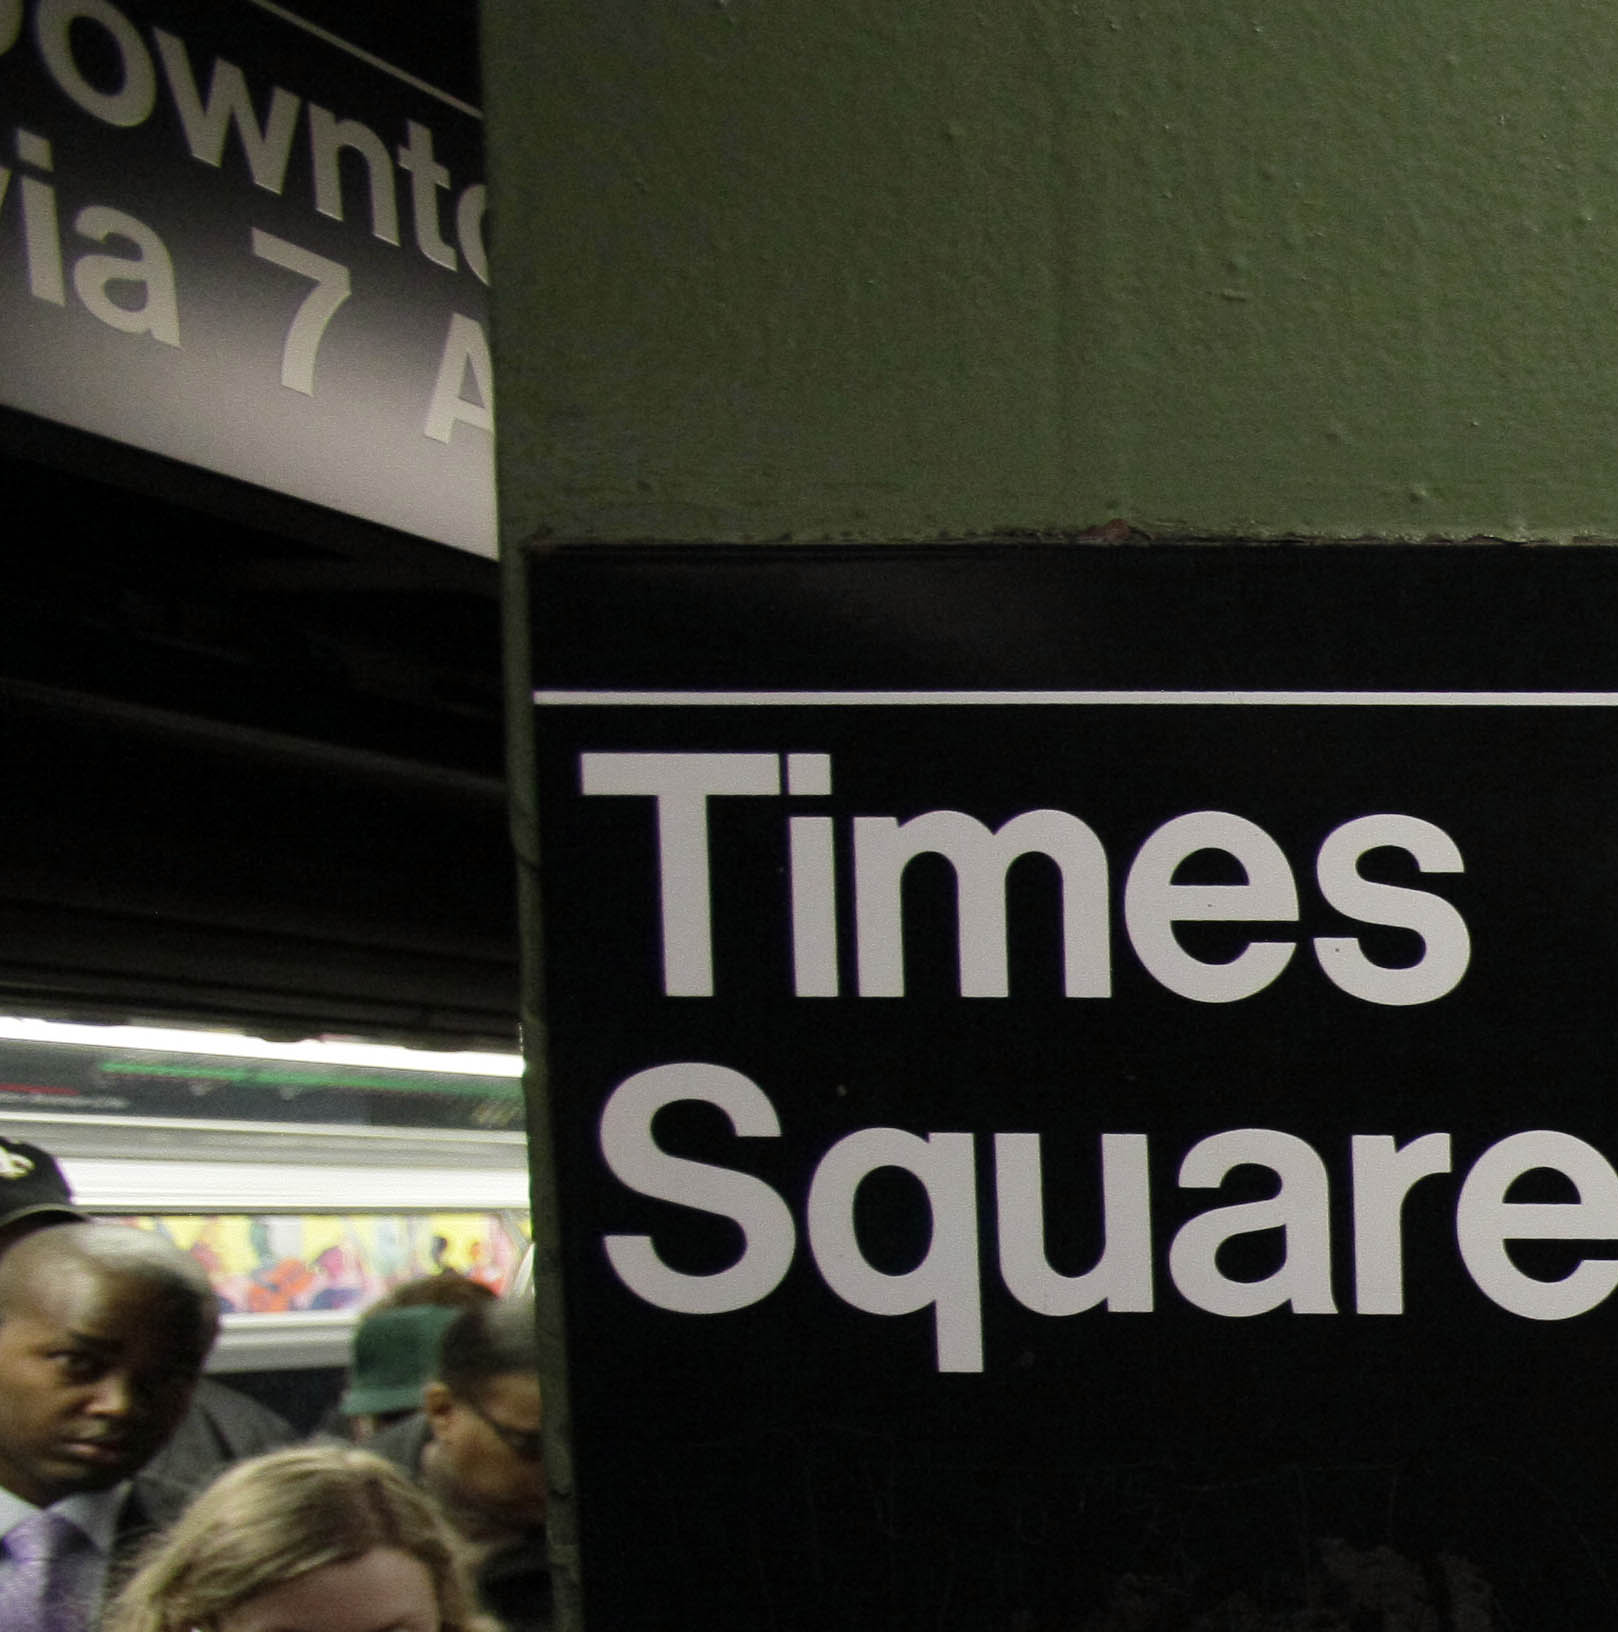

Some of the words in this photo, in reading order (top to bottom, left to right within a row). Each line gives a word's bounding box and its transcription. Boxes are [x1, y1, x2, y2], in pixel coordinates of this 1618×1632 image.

[0, 0, 490, 287] ownt
[0, 127, 183, 349] ia
[251, 226, 352, 399] 7
[580, 752, 1472, 1006] Times
